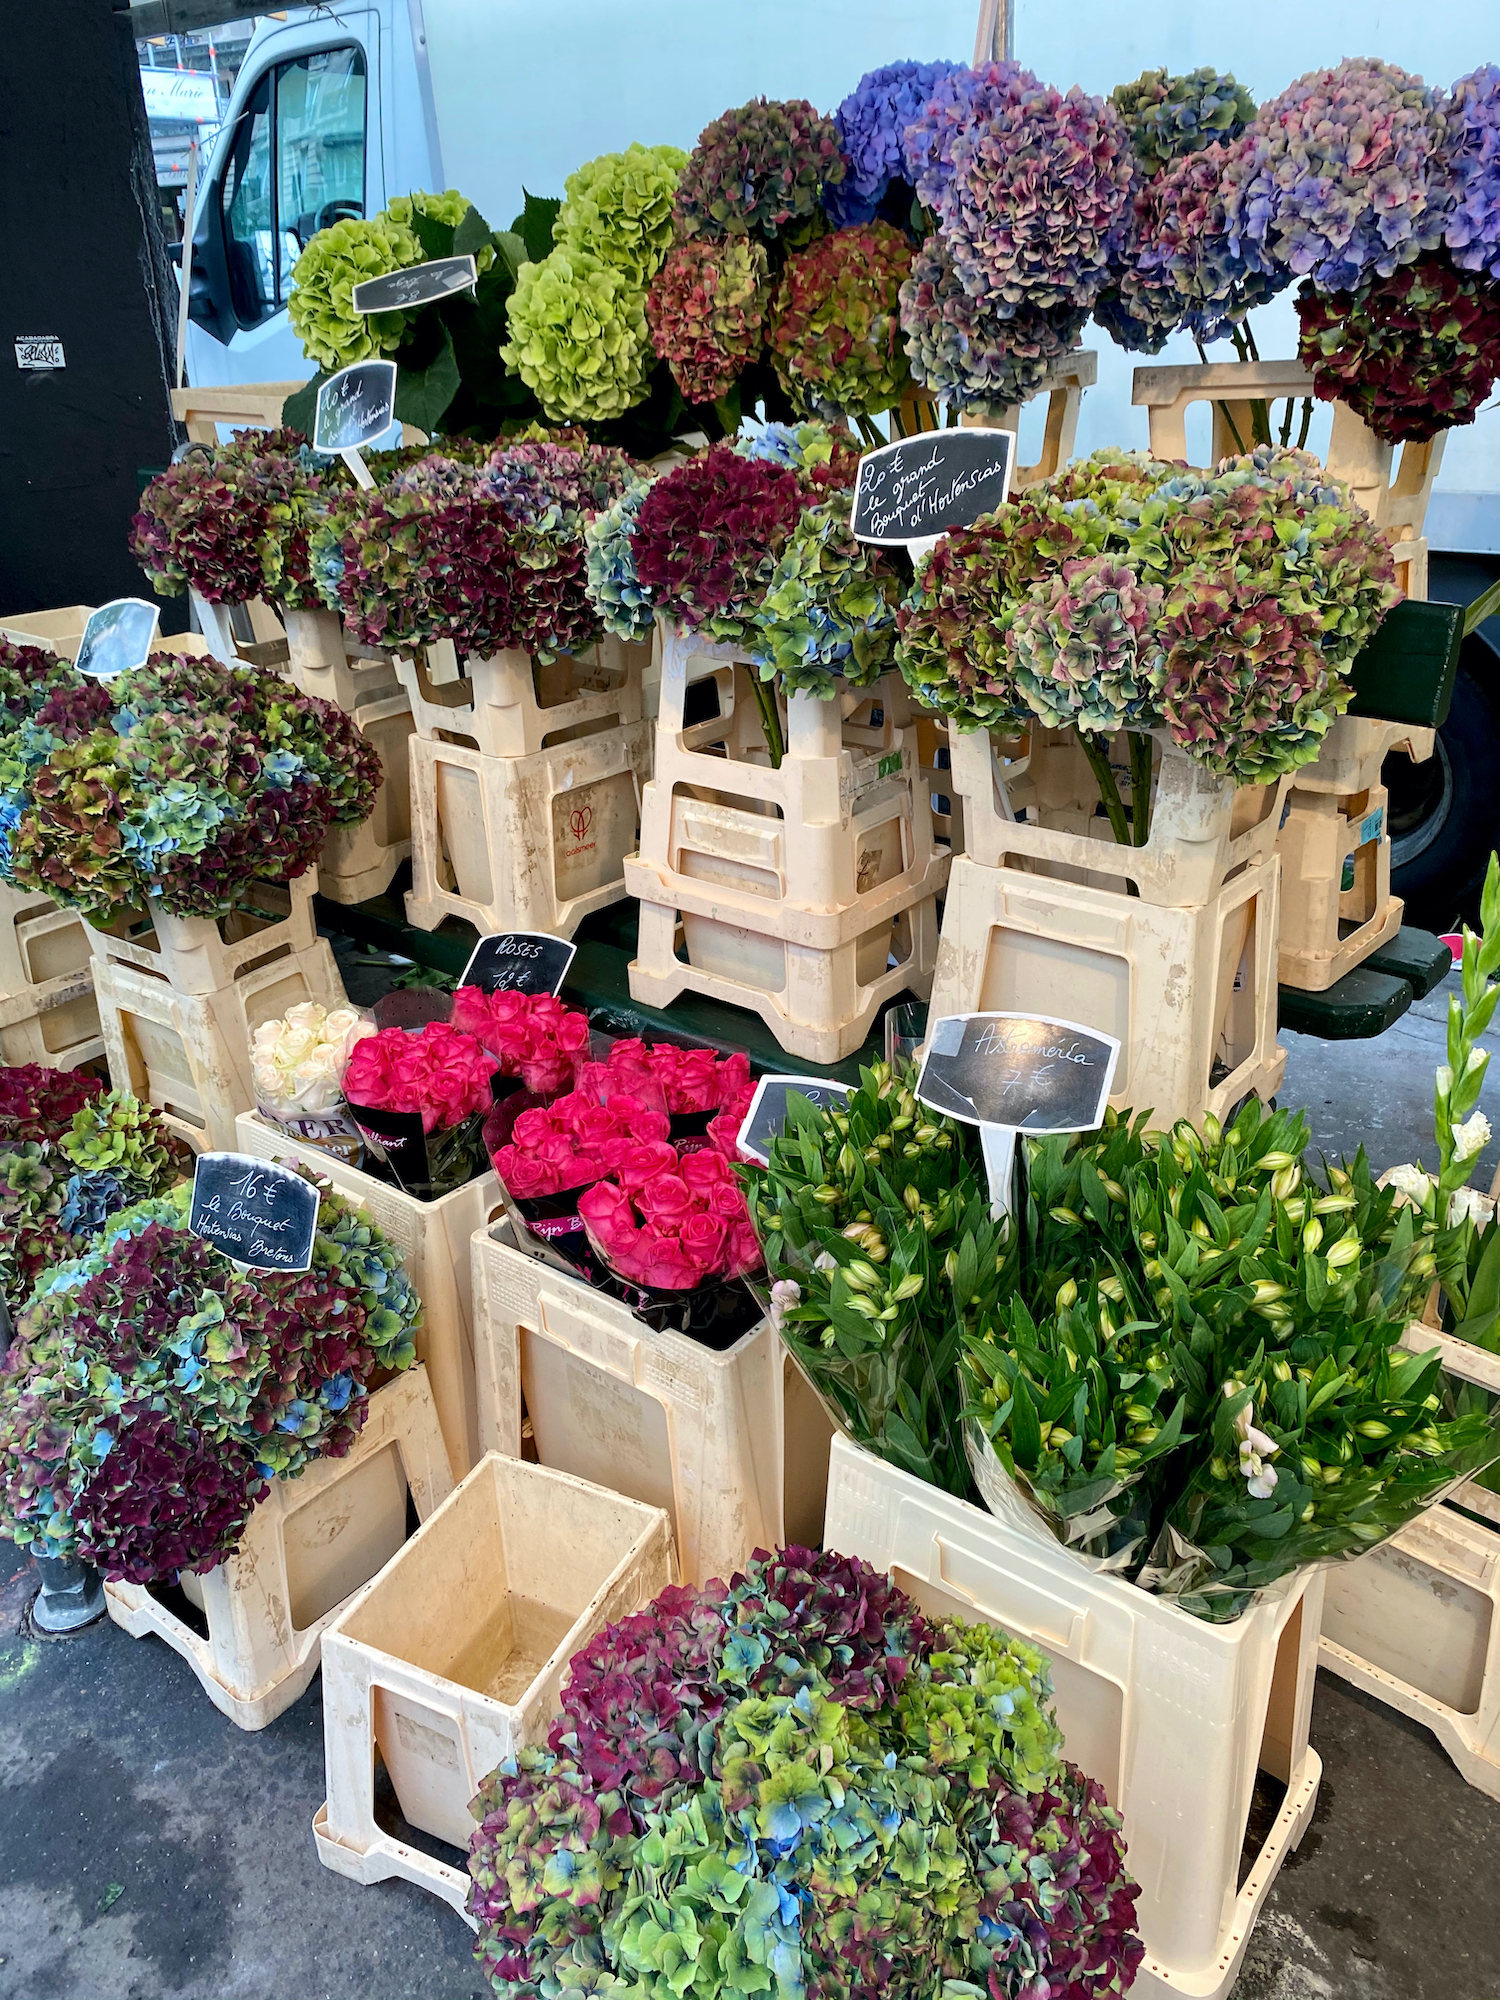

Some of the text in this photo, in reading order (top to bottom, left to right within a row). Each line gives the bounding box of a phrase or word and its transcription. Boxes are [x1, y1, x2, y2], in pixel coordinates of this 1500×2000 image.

[335, 380, 363, 426] grand
[860, 448, 904, 494] 20 €
[862, 445, 946, 516] le grand
[870, 476, 937, 537] Bouquet
[495, 935, 545, 959] ROSES
[516, 970, 532, 987] €
[1002, 1064, 1055, 1096] 7 €
[229, 1170, 286, 1206] 16 €
[201, 1194, 296, 1238] le Bouquet
